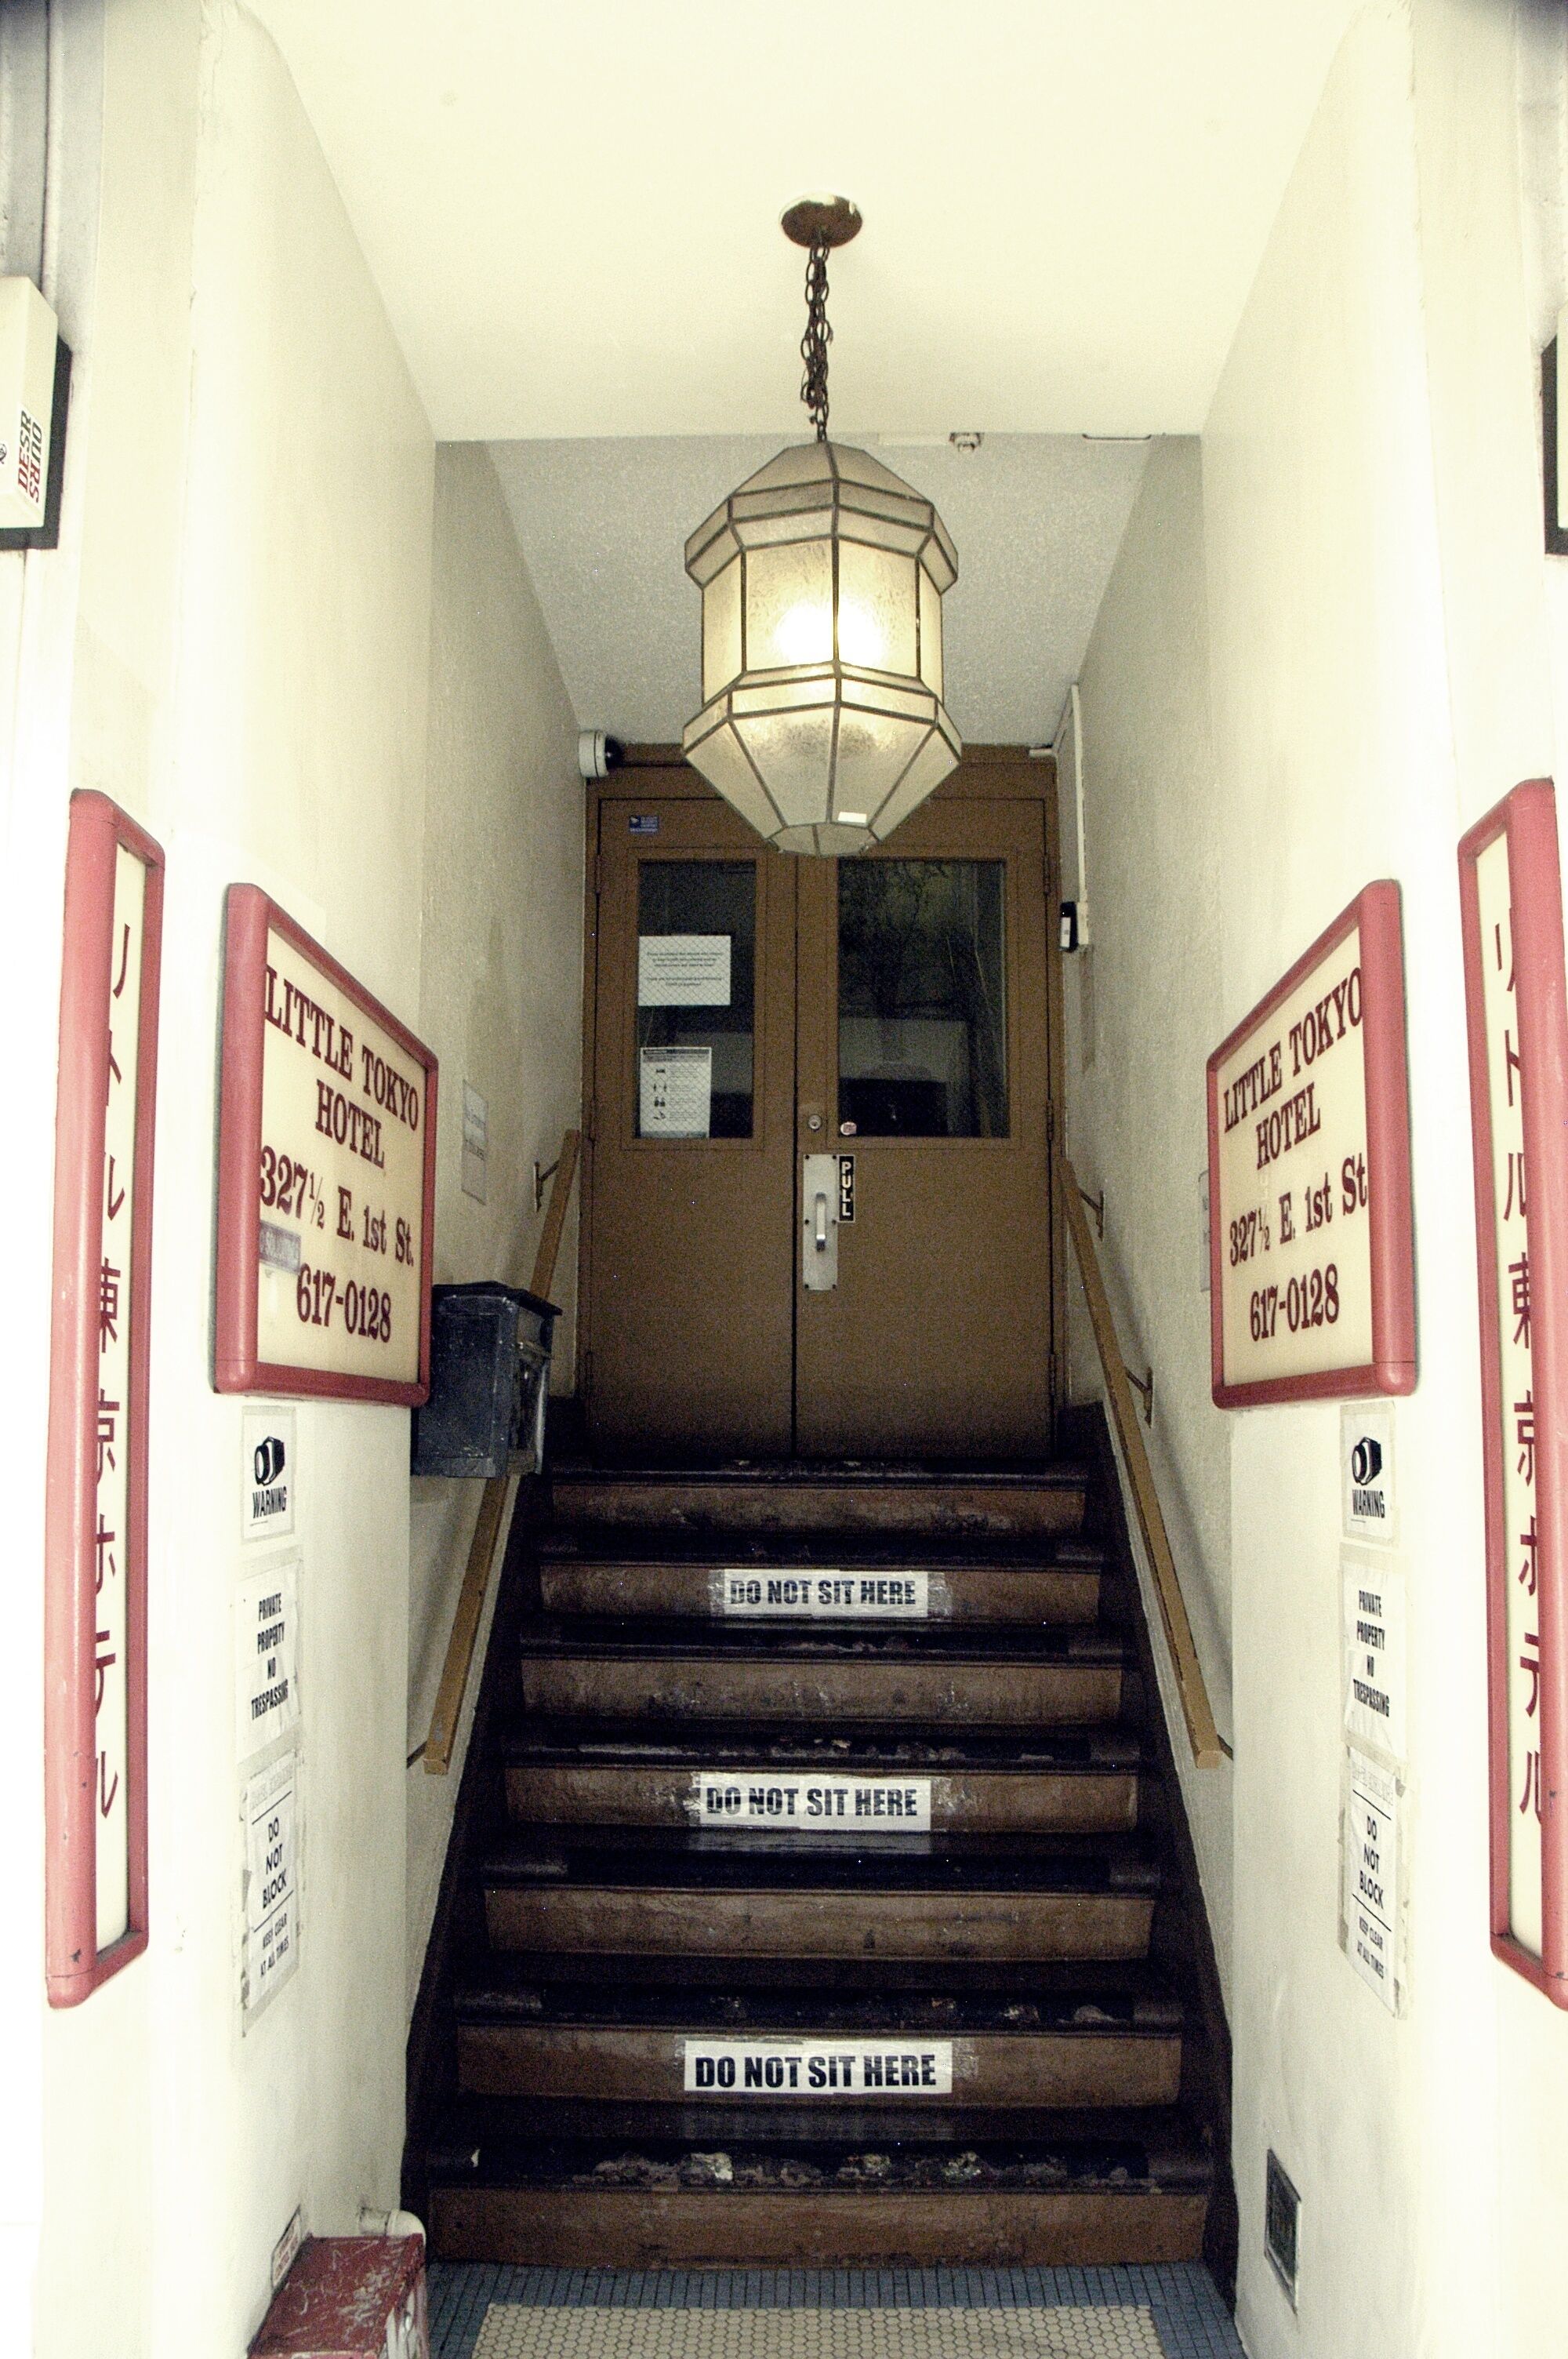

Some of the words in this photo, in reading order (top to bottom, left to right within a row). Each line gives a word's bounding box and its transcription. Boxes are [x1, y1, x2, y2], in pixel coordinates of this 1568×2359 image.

[265, 963, 353, 1082] LITTLE
[361, 1044, 419, 1132] TOKYO
[1224, 1040, 1283, 1134] LITTLE
[1289, 966, 1363, 1078] TOKYO
[315, 1078, 385, 1169] HOTEL
[1256, 1081, 1321, 1171] HOTEL
[841, 1161, 852, 1217] PULL
[1279, 1191, 1295, 1245] E.
[1305, 1172, 1333, 1233] 1st
[1341, 1152, 1367, 1216] St
[336, 1185, 354, 1241] E.
[363, 1205, 387, 1255] 1st
[395, 1216, 414, 1267] St.
[296, 1263, 392, 1343] 617-0128
[1250, 1263, 1340, 1342] 617-0128
[252, 1486, 287, 1520] WARNING
[1352, 1488, 1385, 1520] WARNING
[259, 1592, 283, 1622] PRIVATE
[730, 1579, 760, 1605] DO
[768, 1579, 812, 1605] NOT
[818, 1579, 855, 1605] SIT
[860, 1580, 916, 1605] HERE
[1359, 1590, 1382, 1618] PRIVATE
[257, 1621, 285, 1655] PROPERTY
[1356, 1619, 1385, 1651] PROPERTY
[267, 1656, 277, 1681] NO
[1367, 1654, 1375, 1678] NO
[251, 1678, 289, 1721] TRESPASSING
[1353, 1678, 1390, 1718] TRESPASSING
[707, 1787, 742, 1816] DO
[749, 1787, 799, 1816] NOT
[807, 1788, 848, 1816] SIT
[855, 1788, 917, 1817] HERE
[268, 1816, 279, 1843] DO
[1367, 1816, 1377, 1841] DO
[266, 1843, 283, 1875] NOT
[1363, 1843, 1380, 1874] NOT
[263, 1868, 287, 1909] BLOCK
[1359, 1870, 1384, 1910] BLOCK
[695, 2055, 735, 2088] DO
[745, 2055, 802, 2088] NOT
[808, 2055, 856, 2088] SIT
[862, 2053, 937, 2087] HERE
